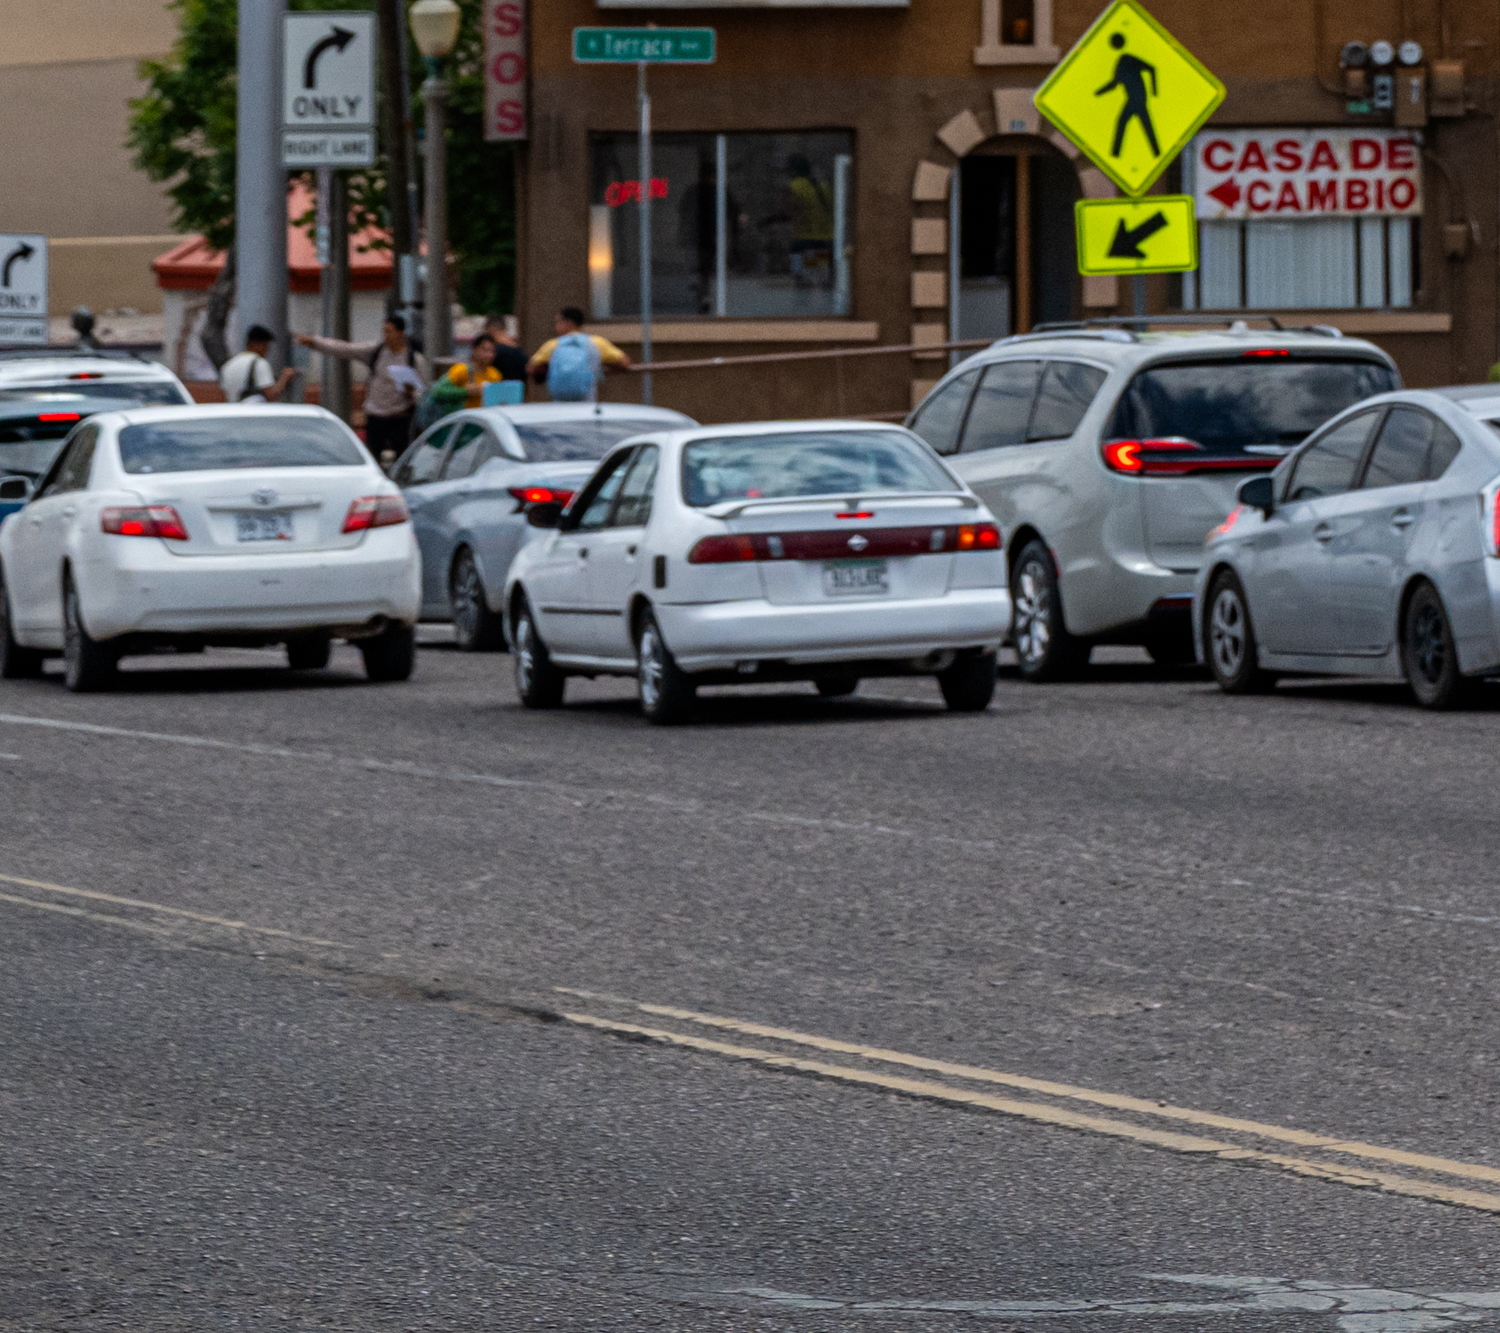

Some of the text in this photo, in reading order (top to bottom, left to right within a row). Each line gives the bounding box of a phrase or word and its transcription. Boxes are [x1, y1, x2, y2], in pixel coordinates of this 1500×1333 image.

[604, 33, 673, 57] Terrace
[292, 96, 362, 119] ONLY
[1202, 138, 1416, 173] CASA DE
[1247, 178, 1416, 212] CAMBIO
